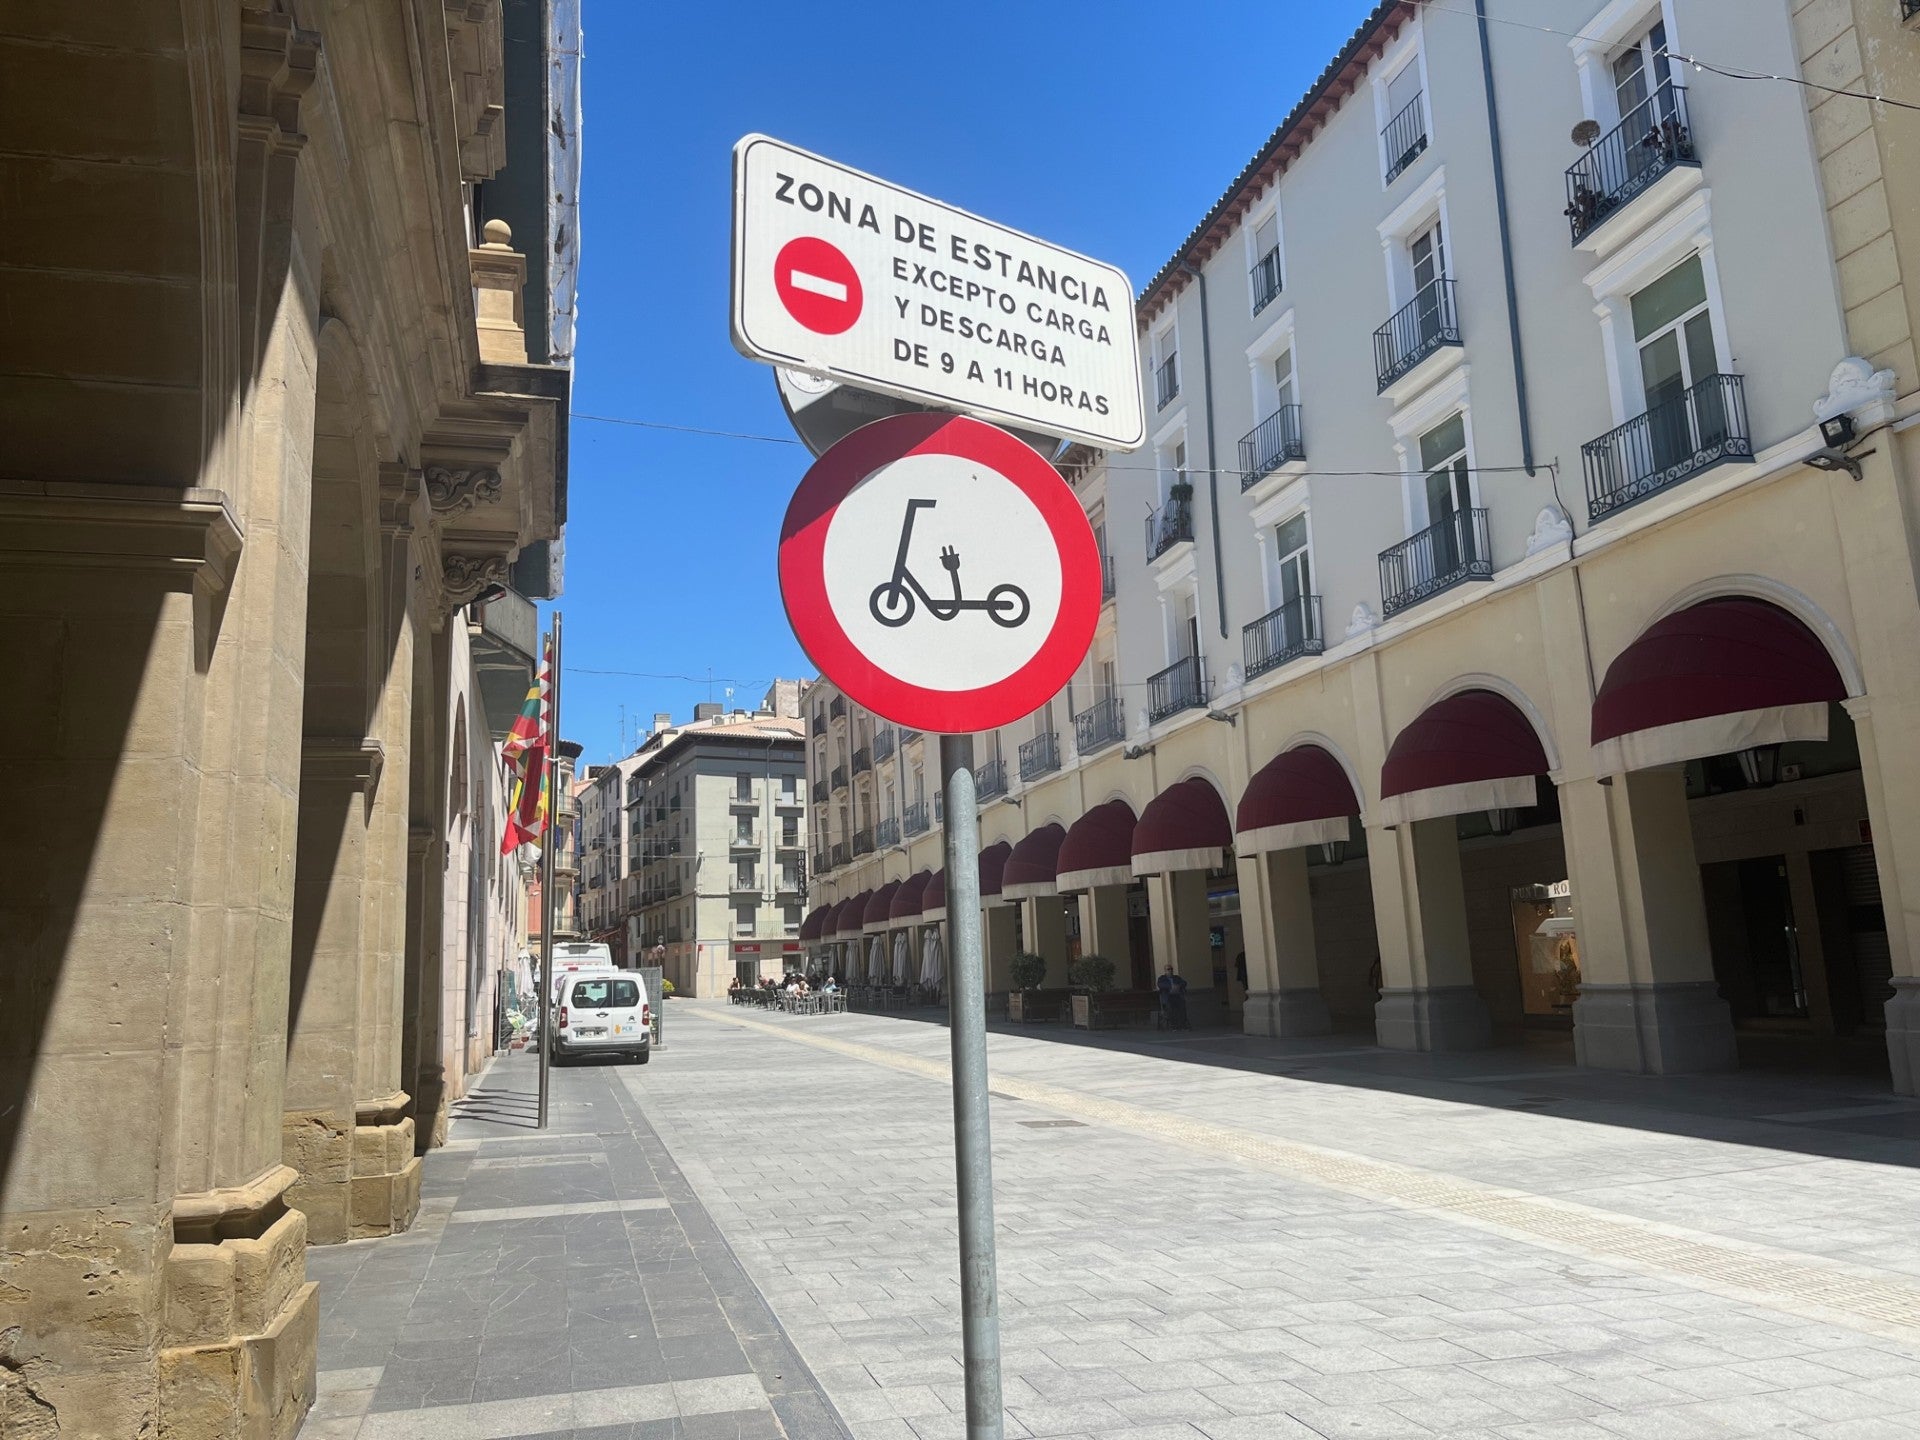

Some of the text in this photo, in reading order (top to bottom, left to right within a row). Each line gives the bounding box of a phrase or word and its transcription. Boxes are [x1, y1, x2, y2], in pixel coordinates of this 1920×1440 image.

[775, 172, 1110, 312] ZONA DE ESTANCIA
[893, 256, 1111, 346] EXCEPTO CARGA
[894, 295, 1066, 367] Y DESCARGA
[894, 338, 1109, 416] DE 9 A 11 HORAS
